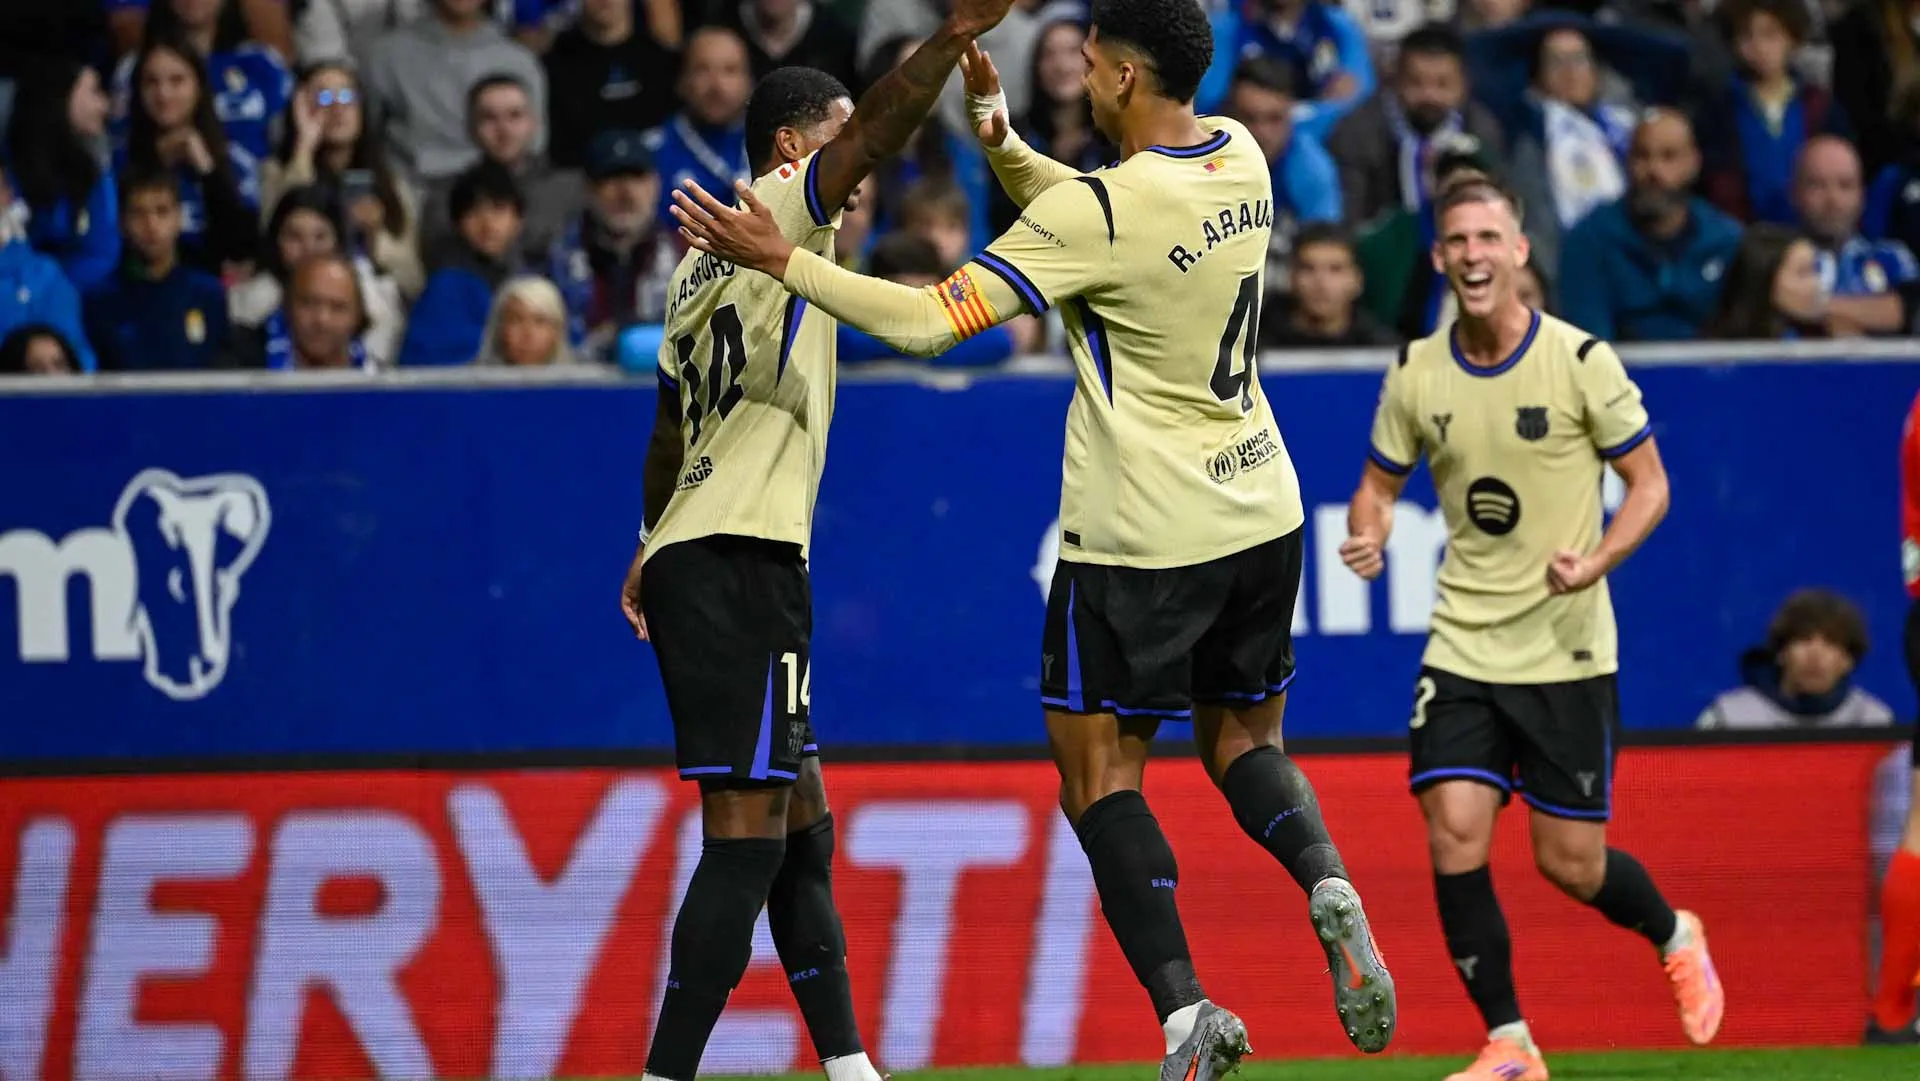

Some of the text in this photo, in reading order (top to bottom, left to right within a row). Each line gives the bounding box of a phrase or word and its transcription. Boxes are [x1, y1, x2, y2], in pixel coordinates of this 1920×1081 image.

[1167, 244, 1203, 274] R.
[1208, 270, 1261, 414] 4
[1240, 440, 1278, 469] ACNUR
